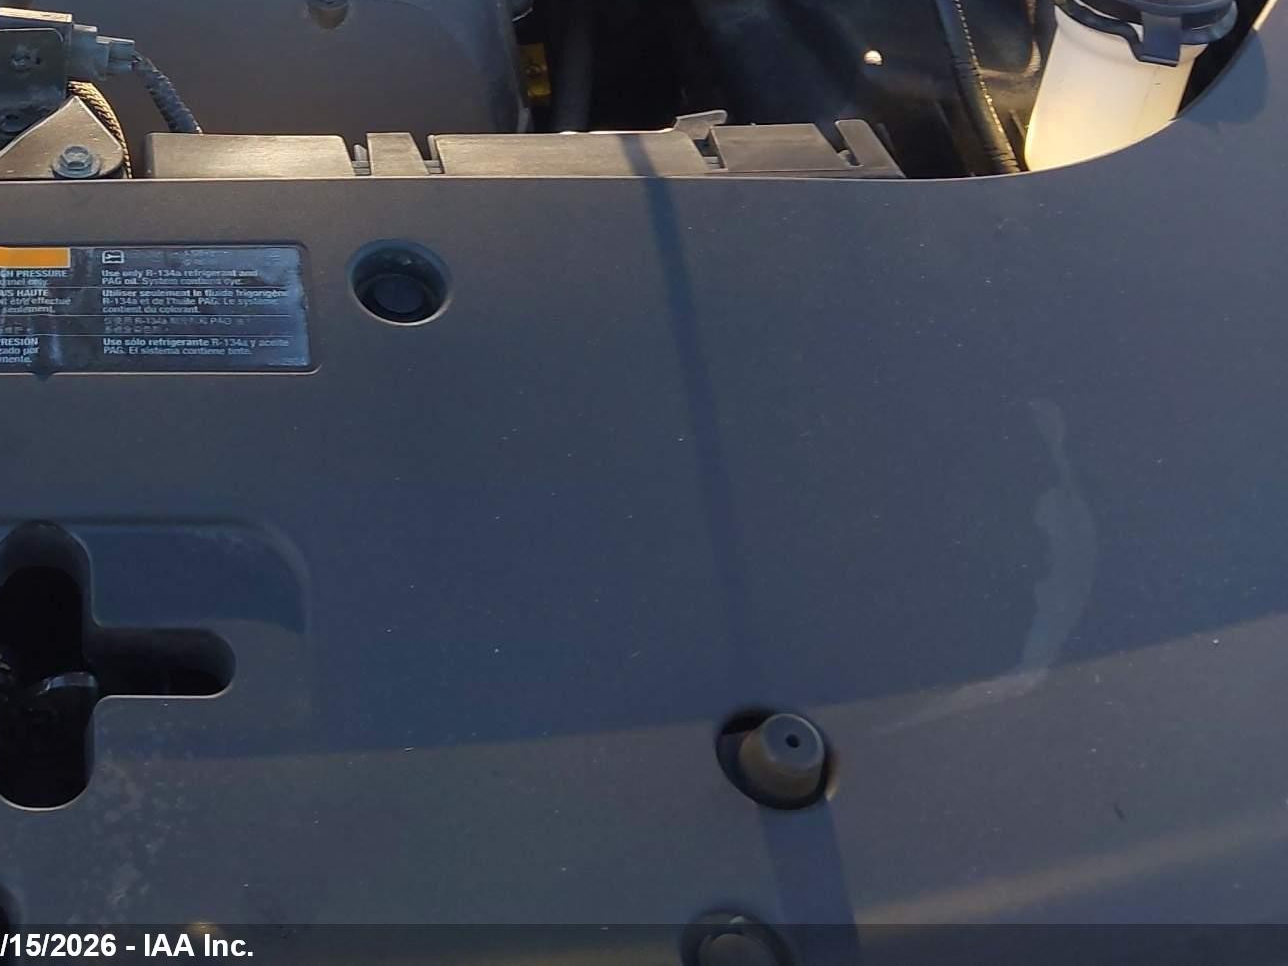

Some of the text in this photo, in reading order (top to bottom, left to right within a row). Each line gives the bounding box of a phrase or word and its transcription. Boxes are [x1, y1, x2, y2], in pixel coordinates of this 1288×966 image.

[16, 270, 68, 278] PRESSURE
[101, 278, 122, 286] PAG
[16, 289, 49, 297] HAUTE
